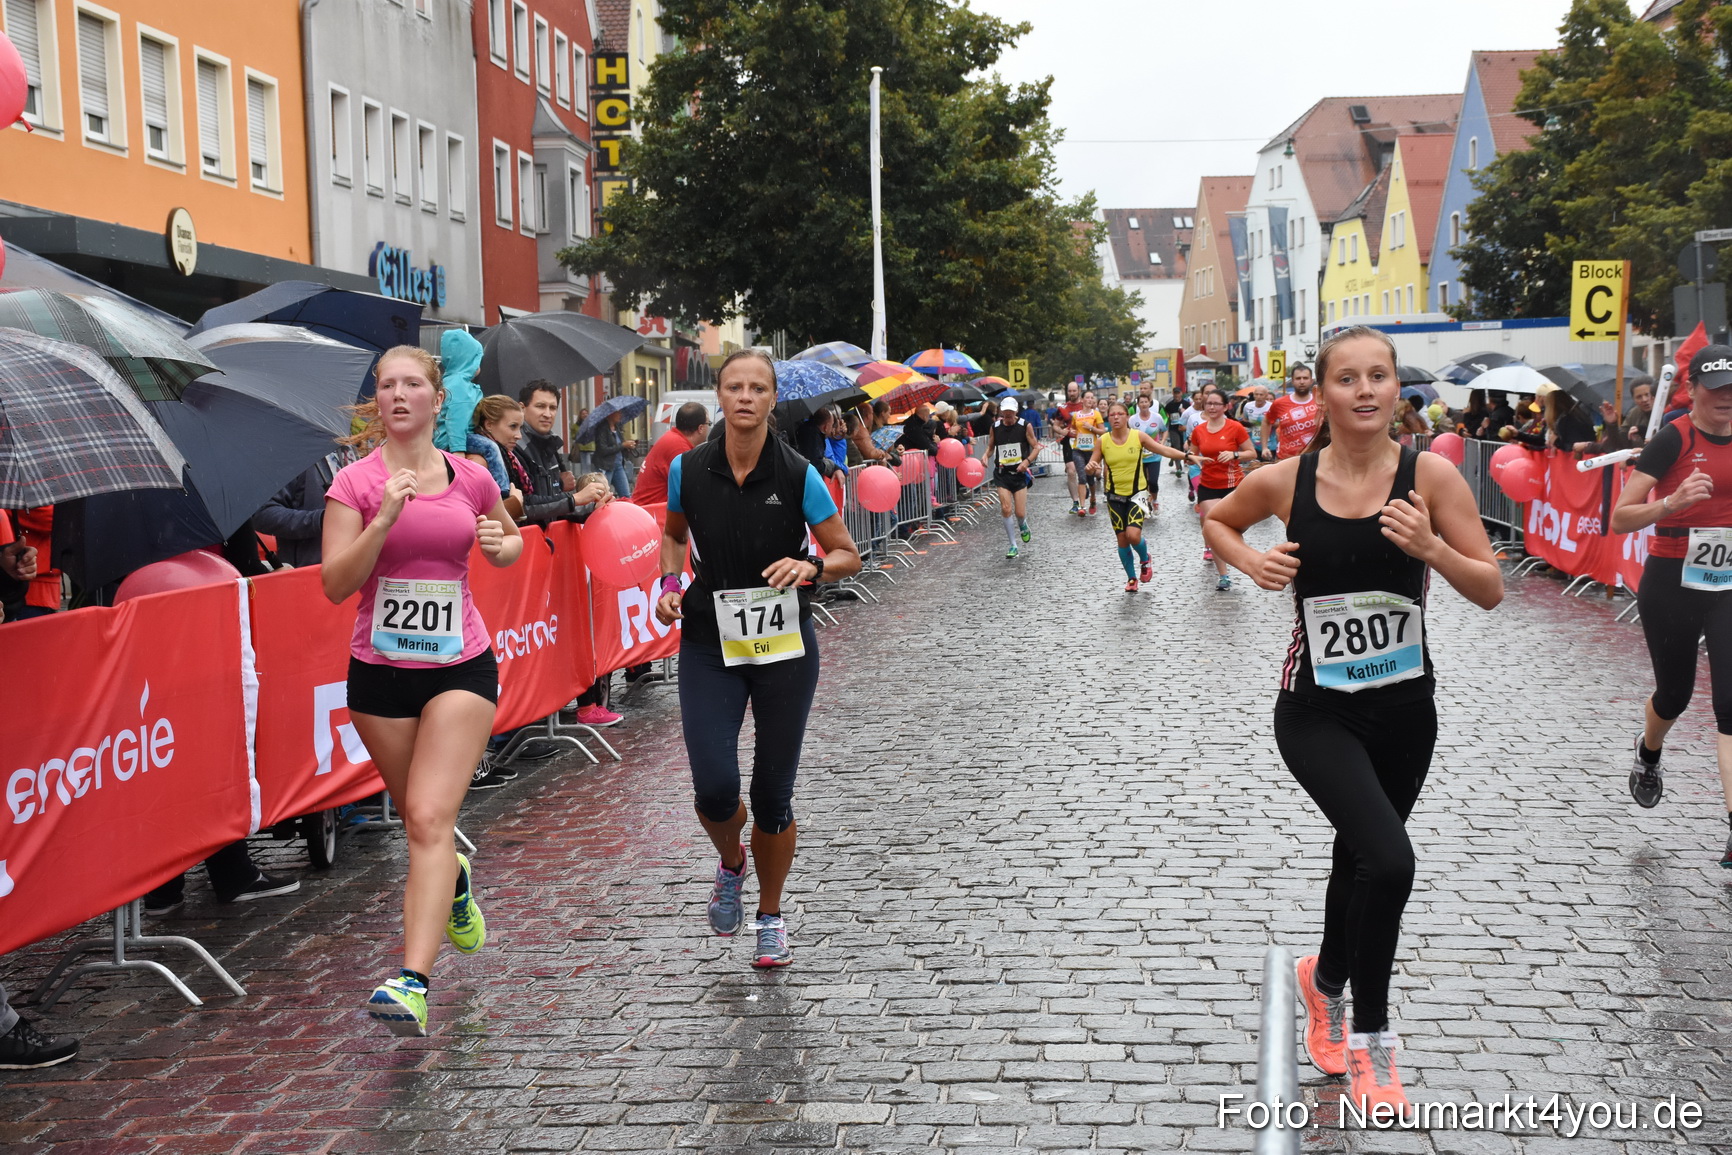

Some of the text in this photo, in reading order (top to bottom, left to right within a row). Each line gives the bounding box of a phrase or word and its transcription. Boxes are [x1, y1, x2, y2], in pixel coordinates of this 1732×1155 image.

[1579, 264, 1623, 279] Block
[1585, 285, 1614, 324] C
[1272, 360, 1282, 373] D
[1014, 369, 1024, 382] D
[1003, 449, 1018, 459] 243
[415, 582, 457, 594] BOCK
[383, 599, 453, 631] 2201
[1313, 605, 1348, 616] NeuerMarkt
[734, 603, 785, 636] 174
[1320, 610, 1411, 658] 2807
[397, 637, 439, 652] Marina
[754, 642, 770, 654] Evi
[1346, 658, 1397, 680] Kathrin
